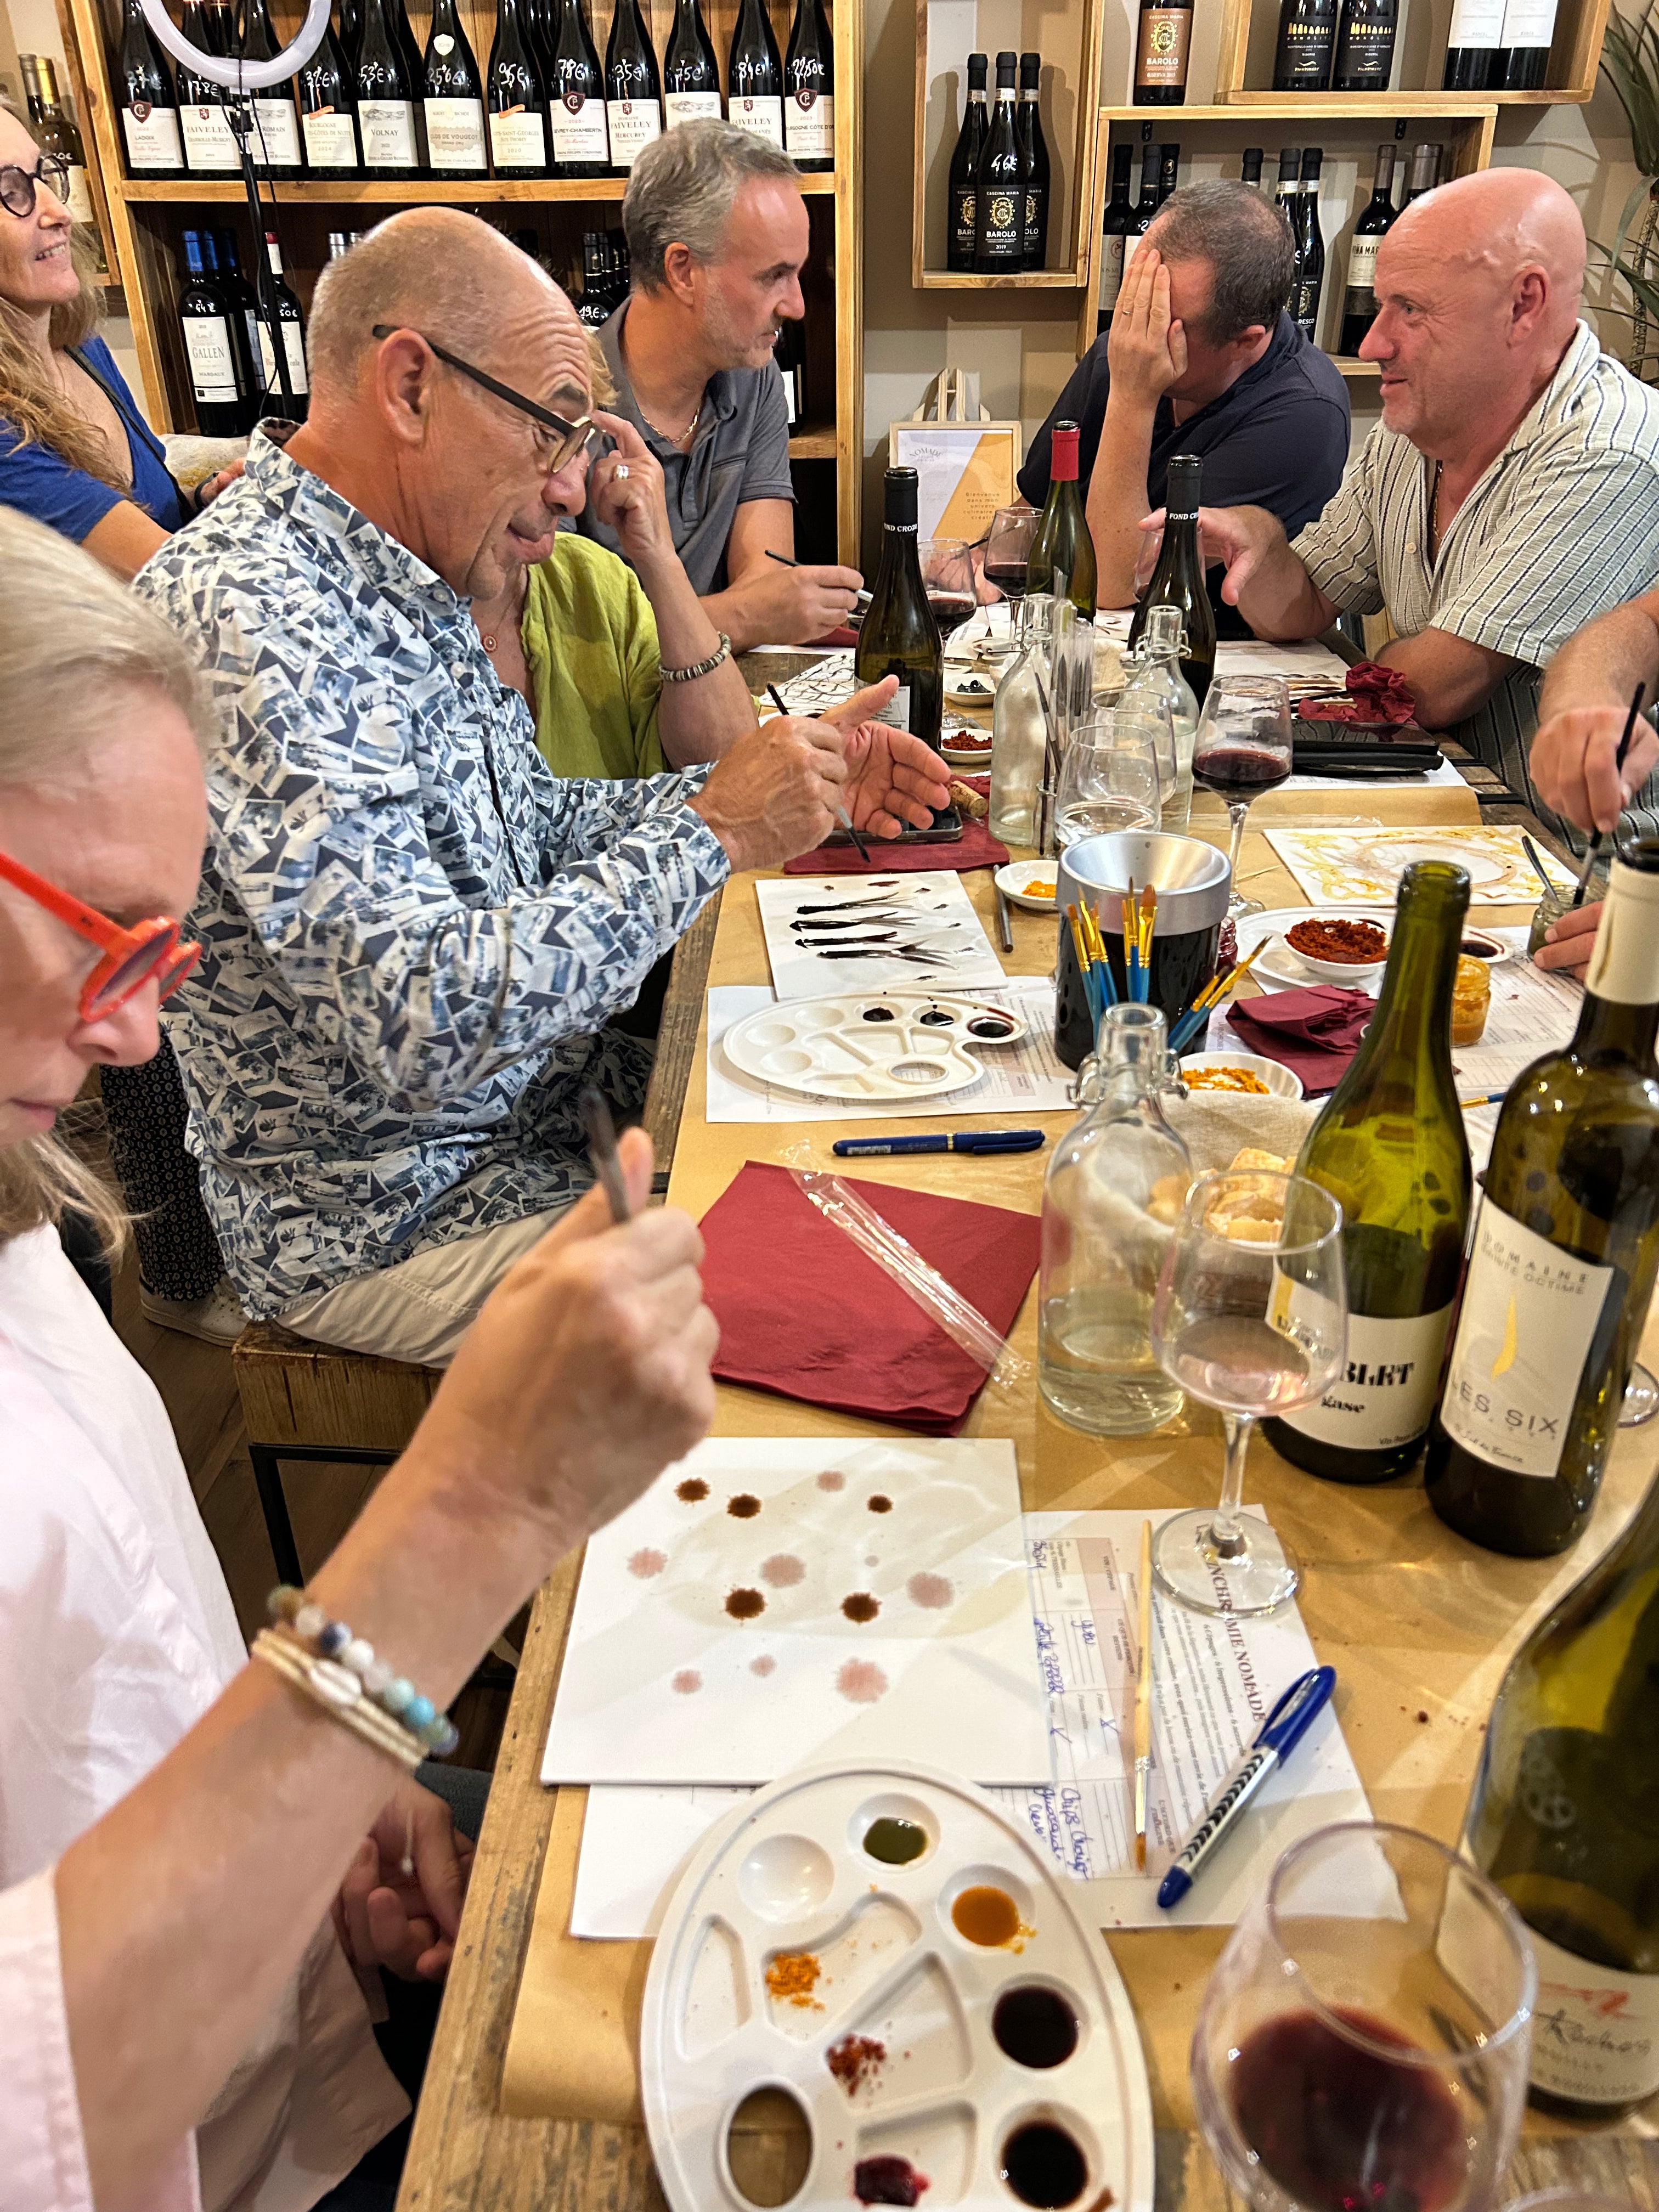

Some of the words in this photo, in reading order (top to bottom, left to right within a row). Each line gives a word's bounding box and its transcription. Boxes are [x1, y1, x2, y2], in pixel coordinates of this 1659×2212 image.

[192, 346, 225, 358] GALLEN
[1483, 1231, 1587, 1283] DOMAINE
[1523, 1272, 1584, 1295] OCTIME
[1451, 1373, 1491, 1413] LES
[1504, 1409, 1560, 1435] SIX
[1233, 1648, 1267, 1724] NOMADE
